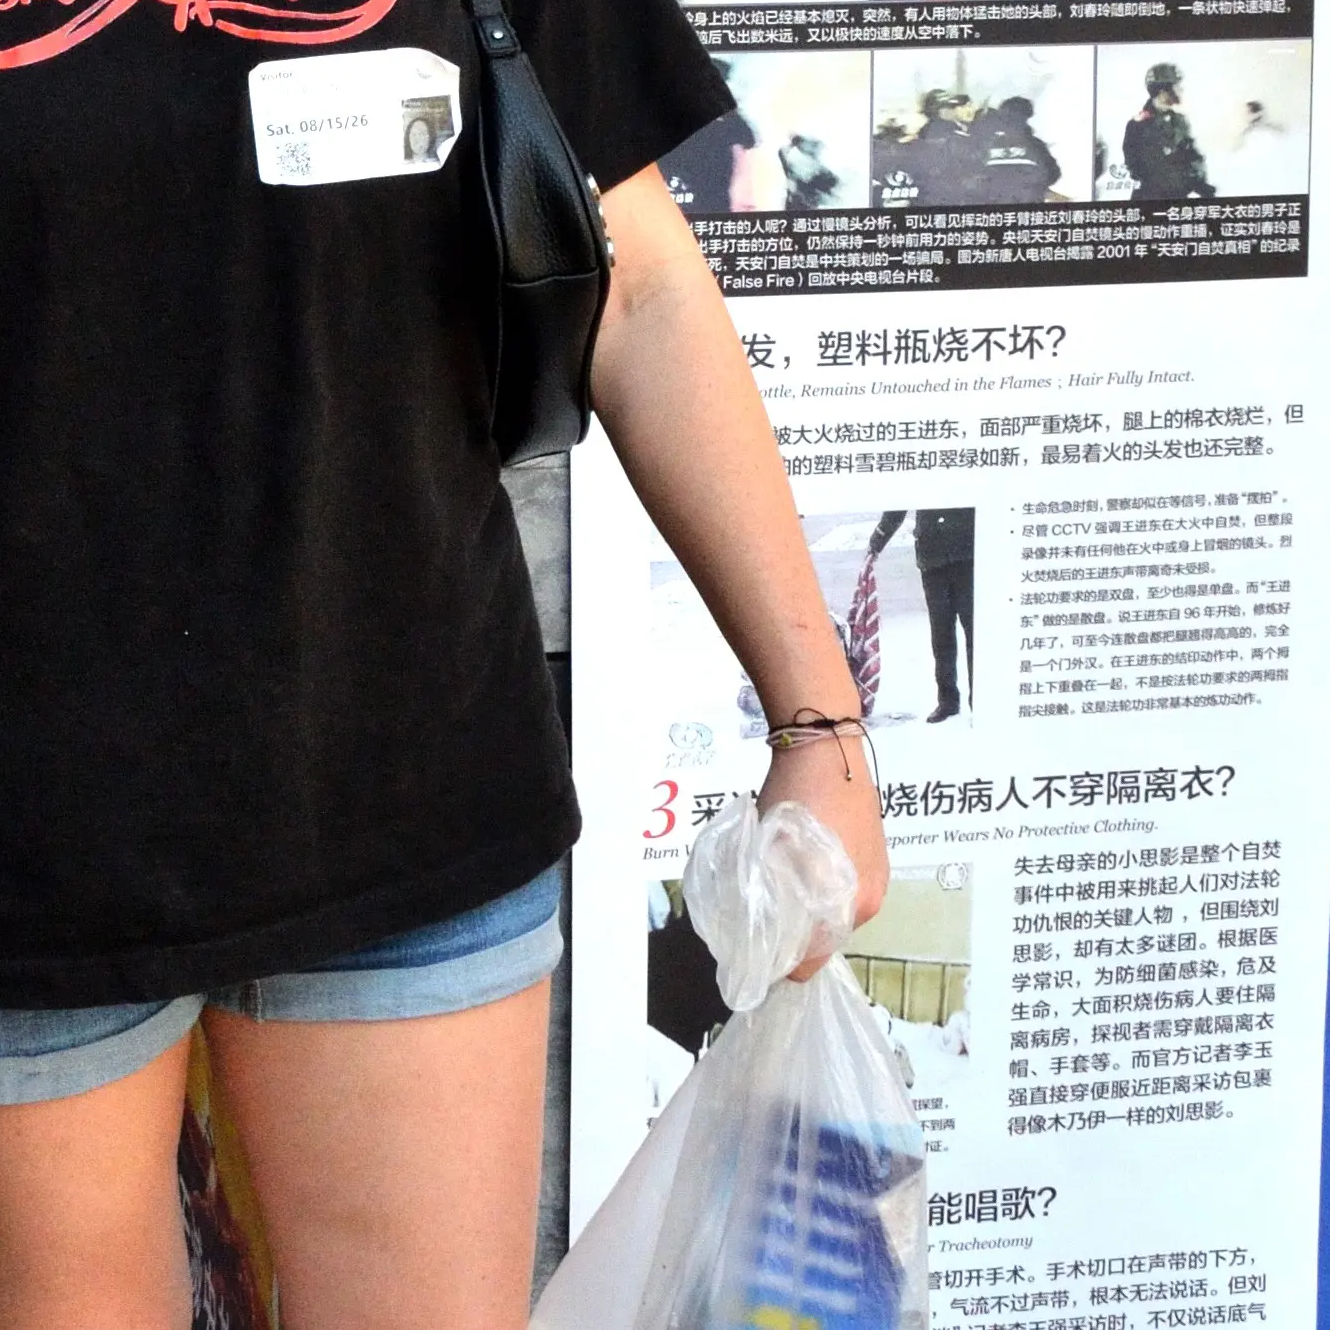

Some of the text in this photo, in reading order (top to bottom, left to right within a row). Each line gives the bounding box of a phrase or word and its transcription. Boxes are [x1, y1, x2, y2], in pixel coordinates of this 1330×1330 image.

[260, 71, 294, 82] Visitor
[266, 114, 369, 137] Sat. 08/15/26
[723, 273, 795, 289] False Fire
[800, 382, 866, 397] Remains
[870, 377, 951, 394] Untouched
[954, 377, 968, 391] in
[972, 376, 995, 390] the
[999, 375, 1051, 389] Flames
[1068, 372, 1103, 387] Hair
[1106, 370, 1143, 387] Fully
[1147, 370, 1194, 383] Intact.
[642, 779, 678, 838] 3
[642, 844, 680, 861] Burn
[938, 1237, 1033, 1252] Tracheotomy
